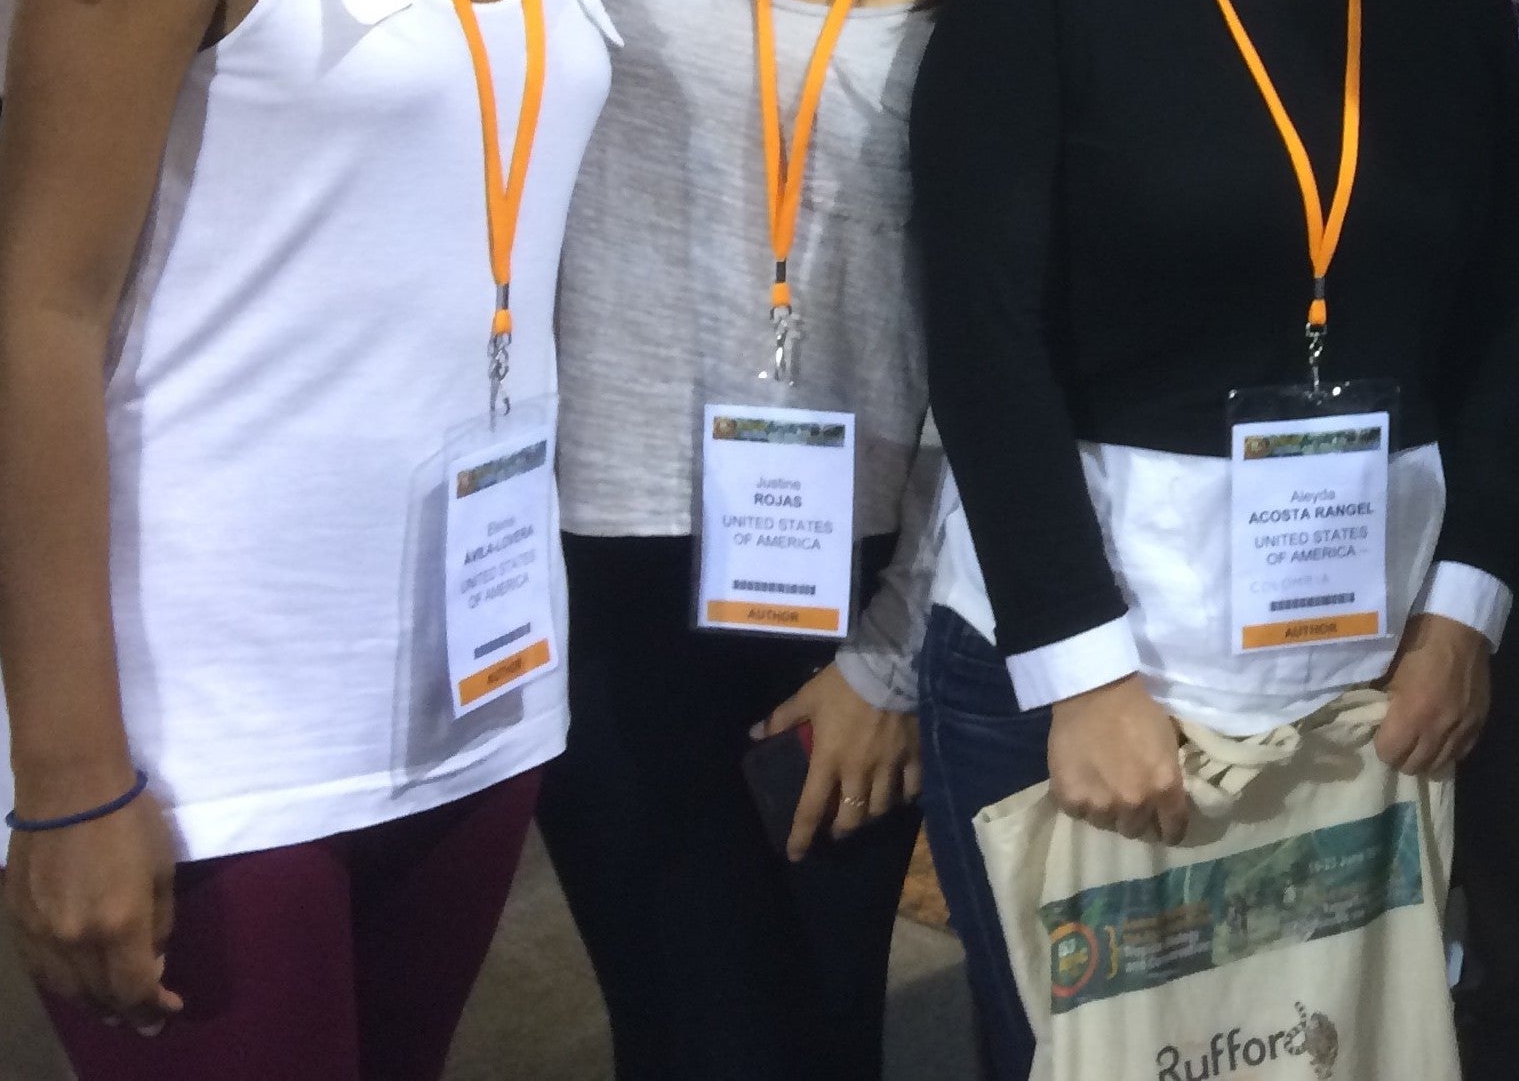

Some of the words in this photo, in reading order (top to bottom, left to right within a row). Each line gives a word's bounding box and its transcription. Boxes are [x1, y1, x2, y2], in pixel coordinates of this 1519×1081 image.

[754, 494, 801, 507] ROJAS
[1250, 511, 1310, 525] ACOSTA
[1315, 502, 1374, 519] RANGEL
[722, 515, 774, 530] UNITED
[779, 518, 833, 533] STATES
[734, 534, 751, 545] OF
[757, 535, 821, 550] AMERICA
[1255, 532, 1308, 549] UNITED
[1313, 526, 1368, 543] STATES
[1266, 552, 1285, 565] OF
[1291, 545, 1356, 563] AMERICA
[749, 608, 799, 622] AUTHOR
[1285, 625, 1338, 638] AUTHOR
